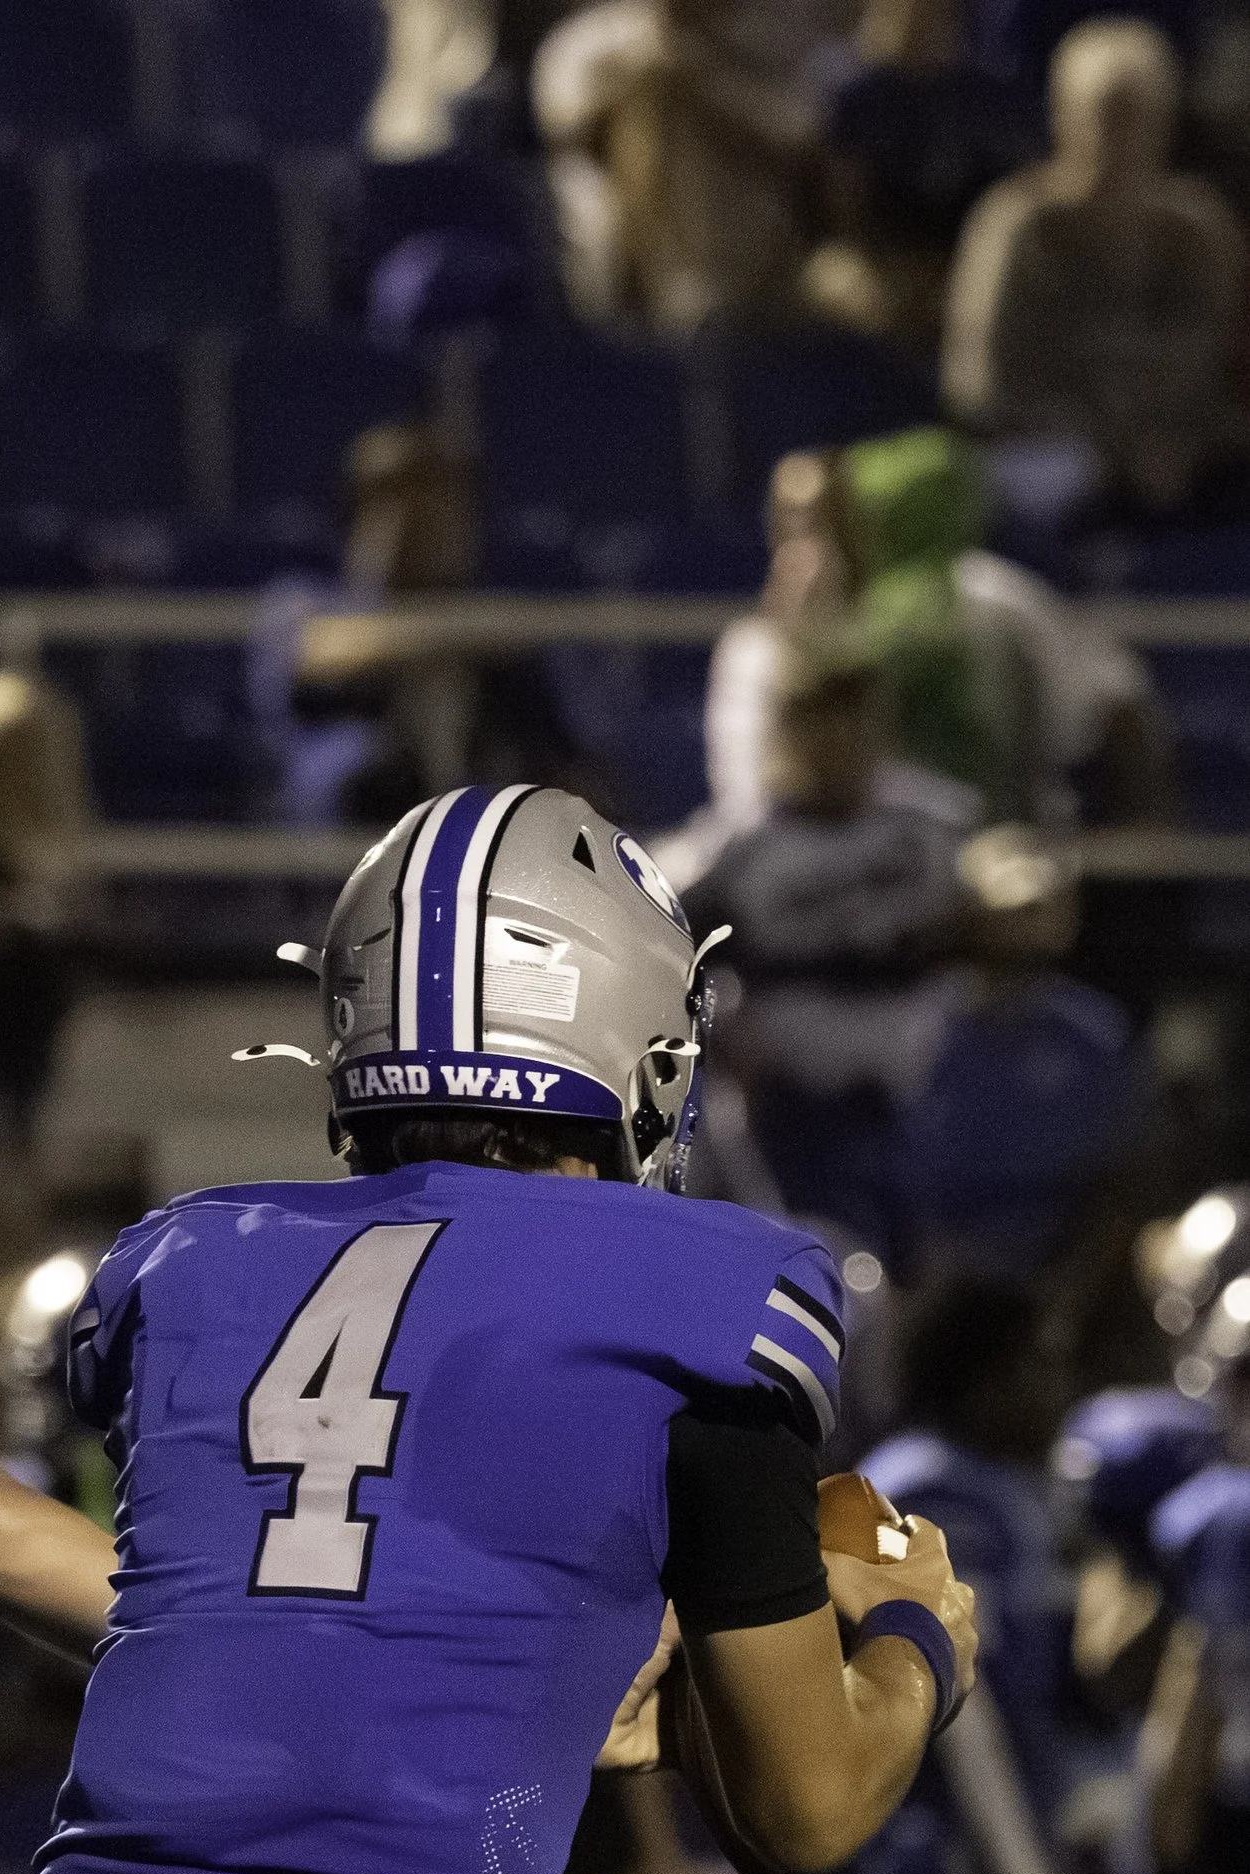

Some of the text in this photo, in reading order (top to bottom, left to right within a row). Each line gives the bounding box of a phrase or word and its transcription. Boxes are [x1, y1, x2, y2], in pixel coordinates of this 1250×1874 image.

[346, 1065, 560, 1102] HARD WAY
[240, 1219, 452, 1601] 4
